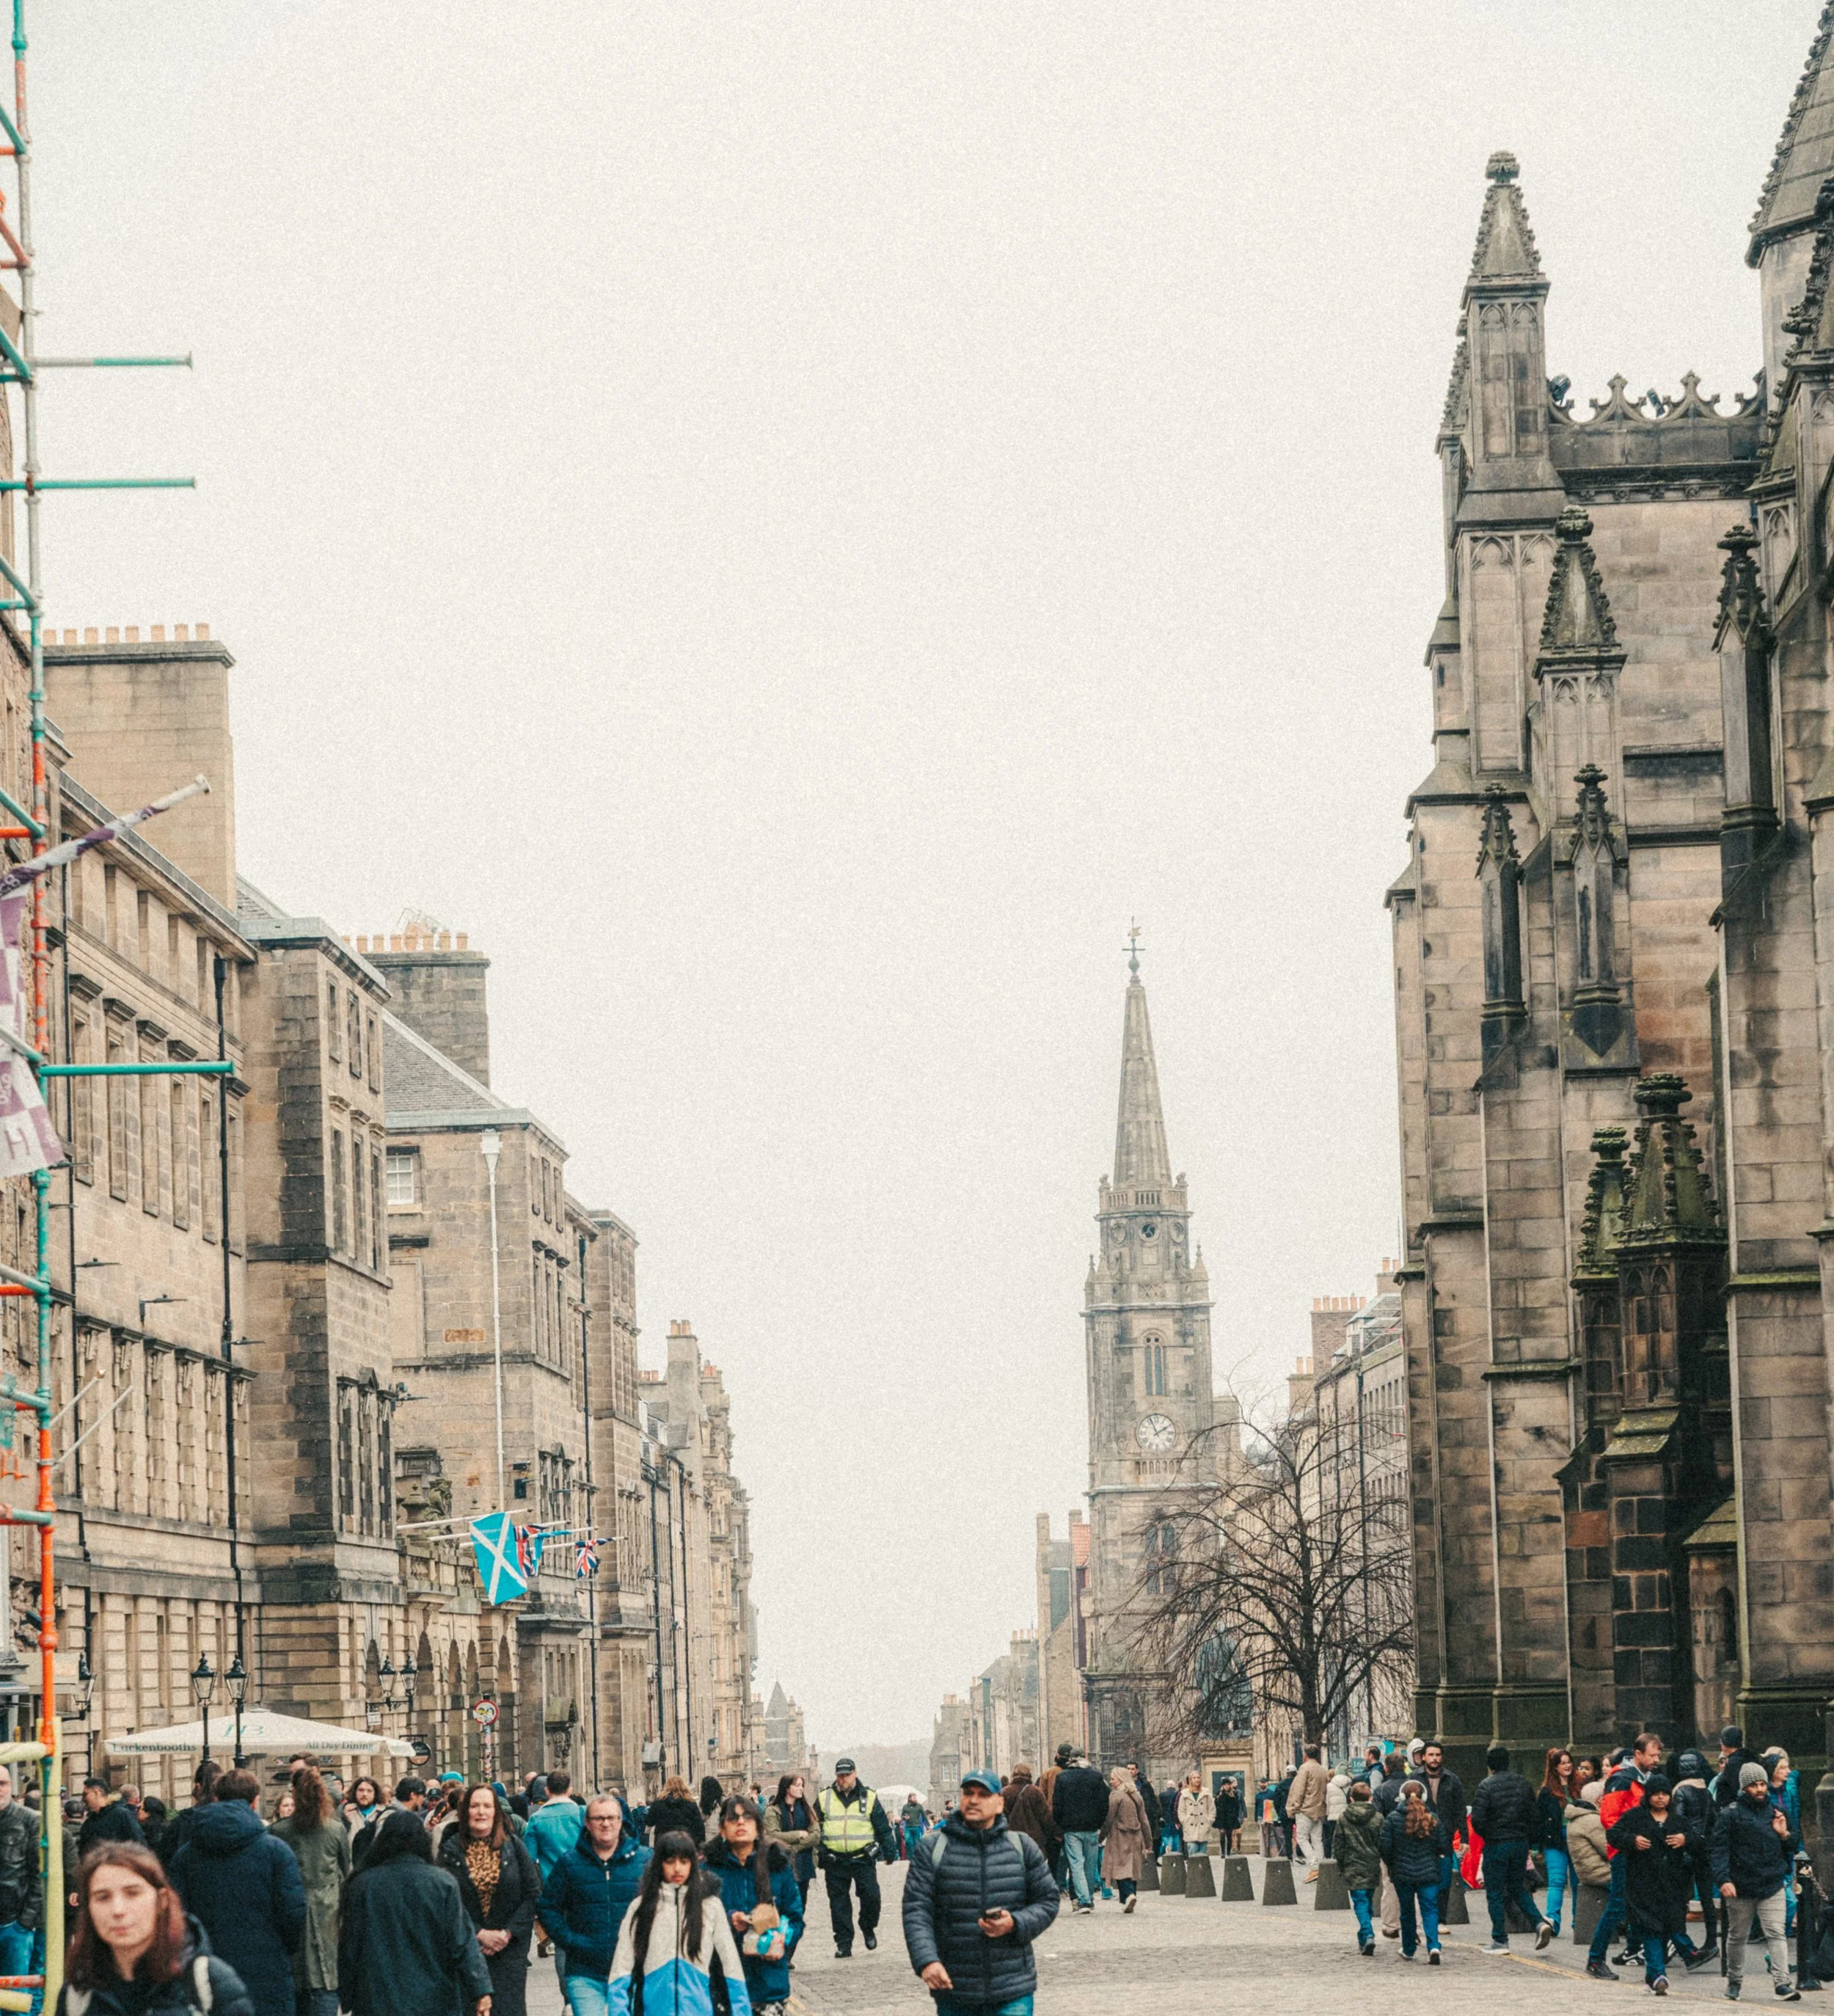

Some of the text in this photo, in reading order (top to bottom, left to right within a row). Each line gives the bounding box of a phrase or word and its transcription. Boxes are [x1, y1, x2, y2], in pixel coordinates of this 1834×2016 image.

[112, 1742, 197, 1753] Luckenbooths
[306, 1742, 374, 1752] All Day Dining
